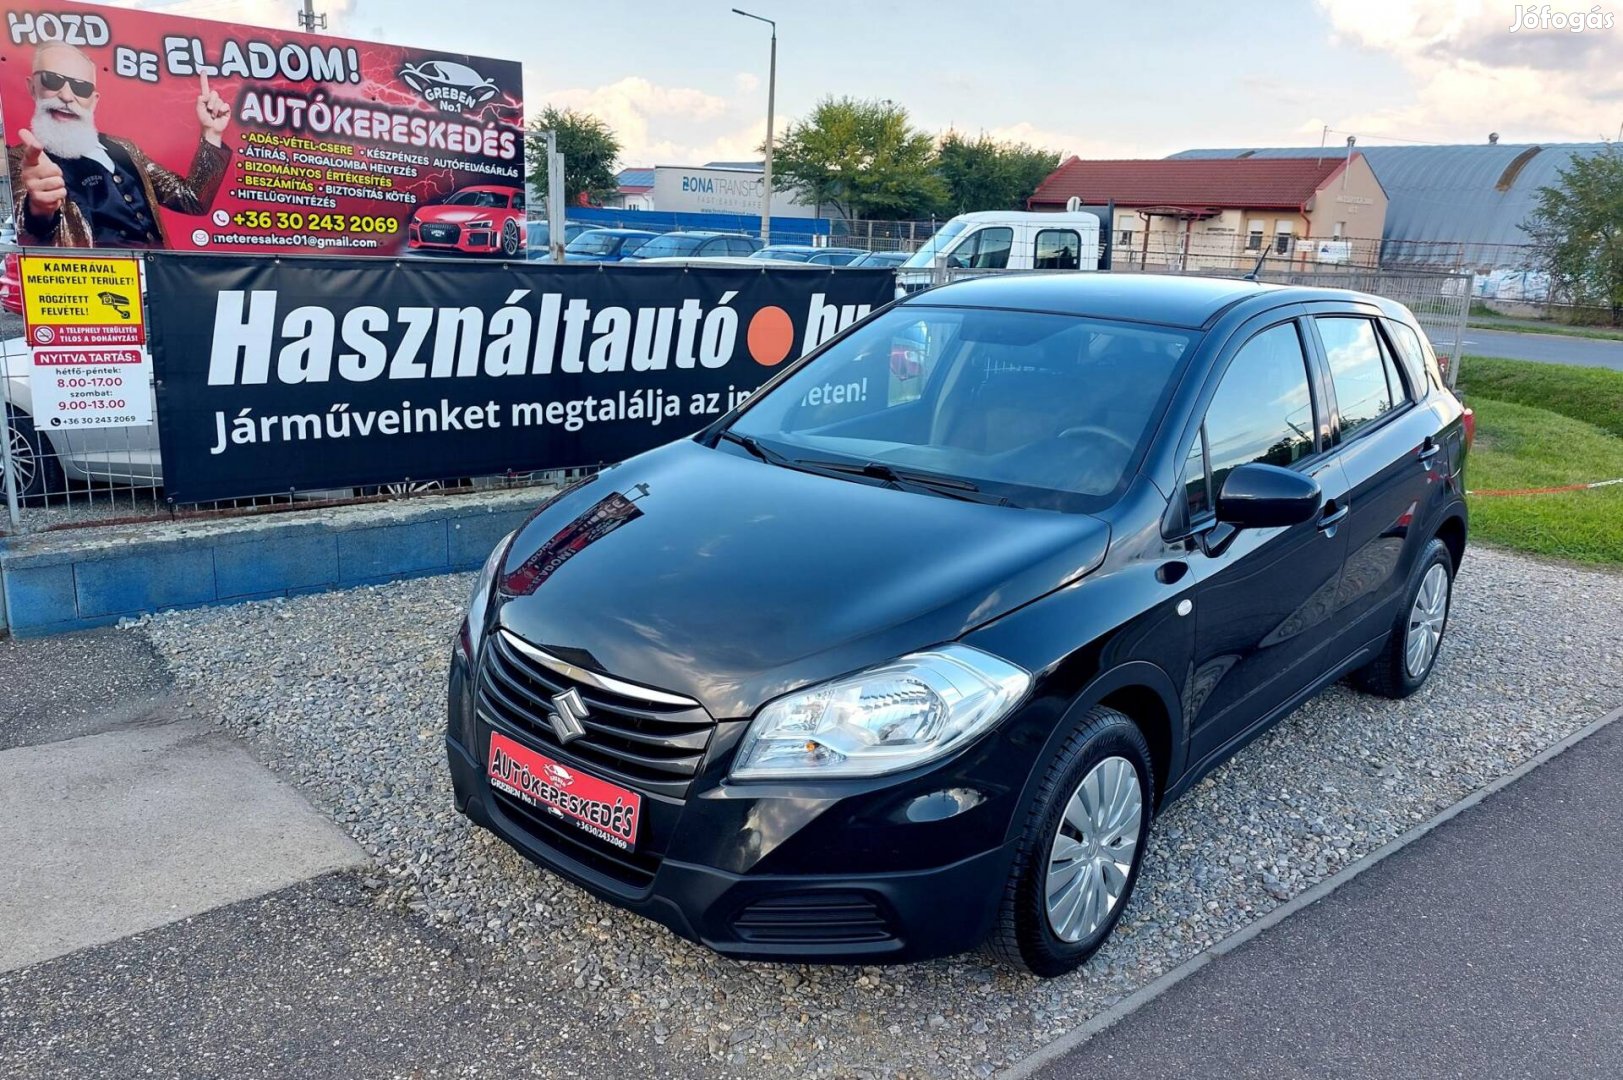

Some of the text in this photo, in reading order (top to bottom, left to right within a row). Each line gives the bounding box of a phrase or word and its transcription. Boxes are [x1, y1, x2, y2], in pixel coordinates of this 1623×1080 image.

[8, 12, 109, 46] HOZD
[116, 37, 360, 84] BE ELADOM!
[424, 86, 476, 109] GREBEN
[440, 101, 461, 113] No.1
[241, 92, 517, 160] AUTÓKERESKEDÉS
[249, 132, 353, 155] ADÁS-VÉTEL-CSERE
[293, 153, 368, 171] FORGALOMBA
[370, 164, 417, 177] HELYEZÉS
[367, 149, 519, 178] KÉSZPÉNZES AUTÓFELVÁSÁRLÁS
[245, 161, 393, 188] BIZOMÁNYOS ÉRTÉKESÍTÉS
[238, 189, 337, 208] HITELÜGYINTÉZÉS
[245, 175, 417, 204] BESZÁMÍTÁS BIZTOSÍTÁS KÖTÉS
[233, 211, 398, 234] +36 30 243 2069
[213, 233, 377, 248] meteresakac01@gmail.com
[44, 262, 116, 273] KAMERÁVAL
[27, 275, 134, 285] MEGFIGYELT TERÜLET!
[39, 292, 89, 304] RÖGZÍTETT
[41, 305, 89, 316] FELVÉTEL!
[40, 351, 136, 364] NYITVA TARTÁS:
[57, 377, 123, 388] 8.00-17.00
[70, 390, 113, 398] szombat:
[58, 399, 126, 411] 9.00-13.00
[63, 417, 79, 425] +36
[95, 416, 112, 424] 243
[210, 399, 500, 455] Járműveinket
[512, 389, 680, 431] megtalálja
[689, 393, 720, 414] az
[491, 777, 521, 798] GREBEN
[491, 747, 634, 838] AUTÓKERESKEDÉS
